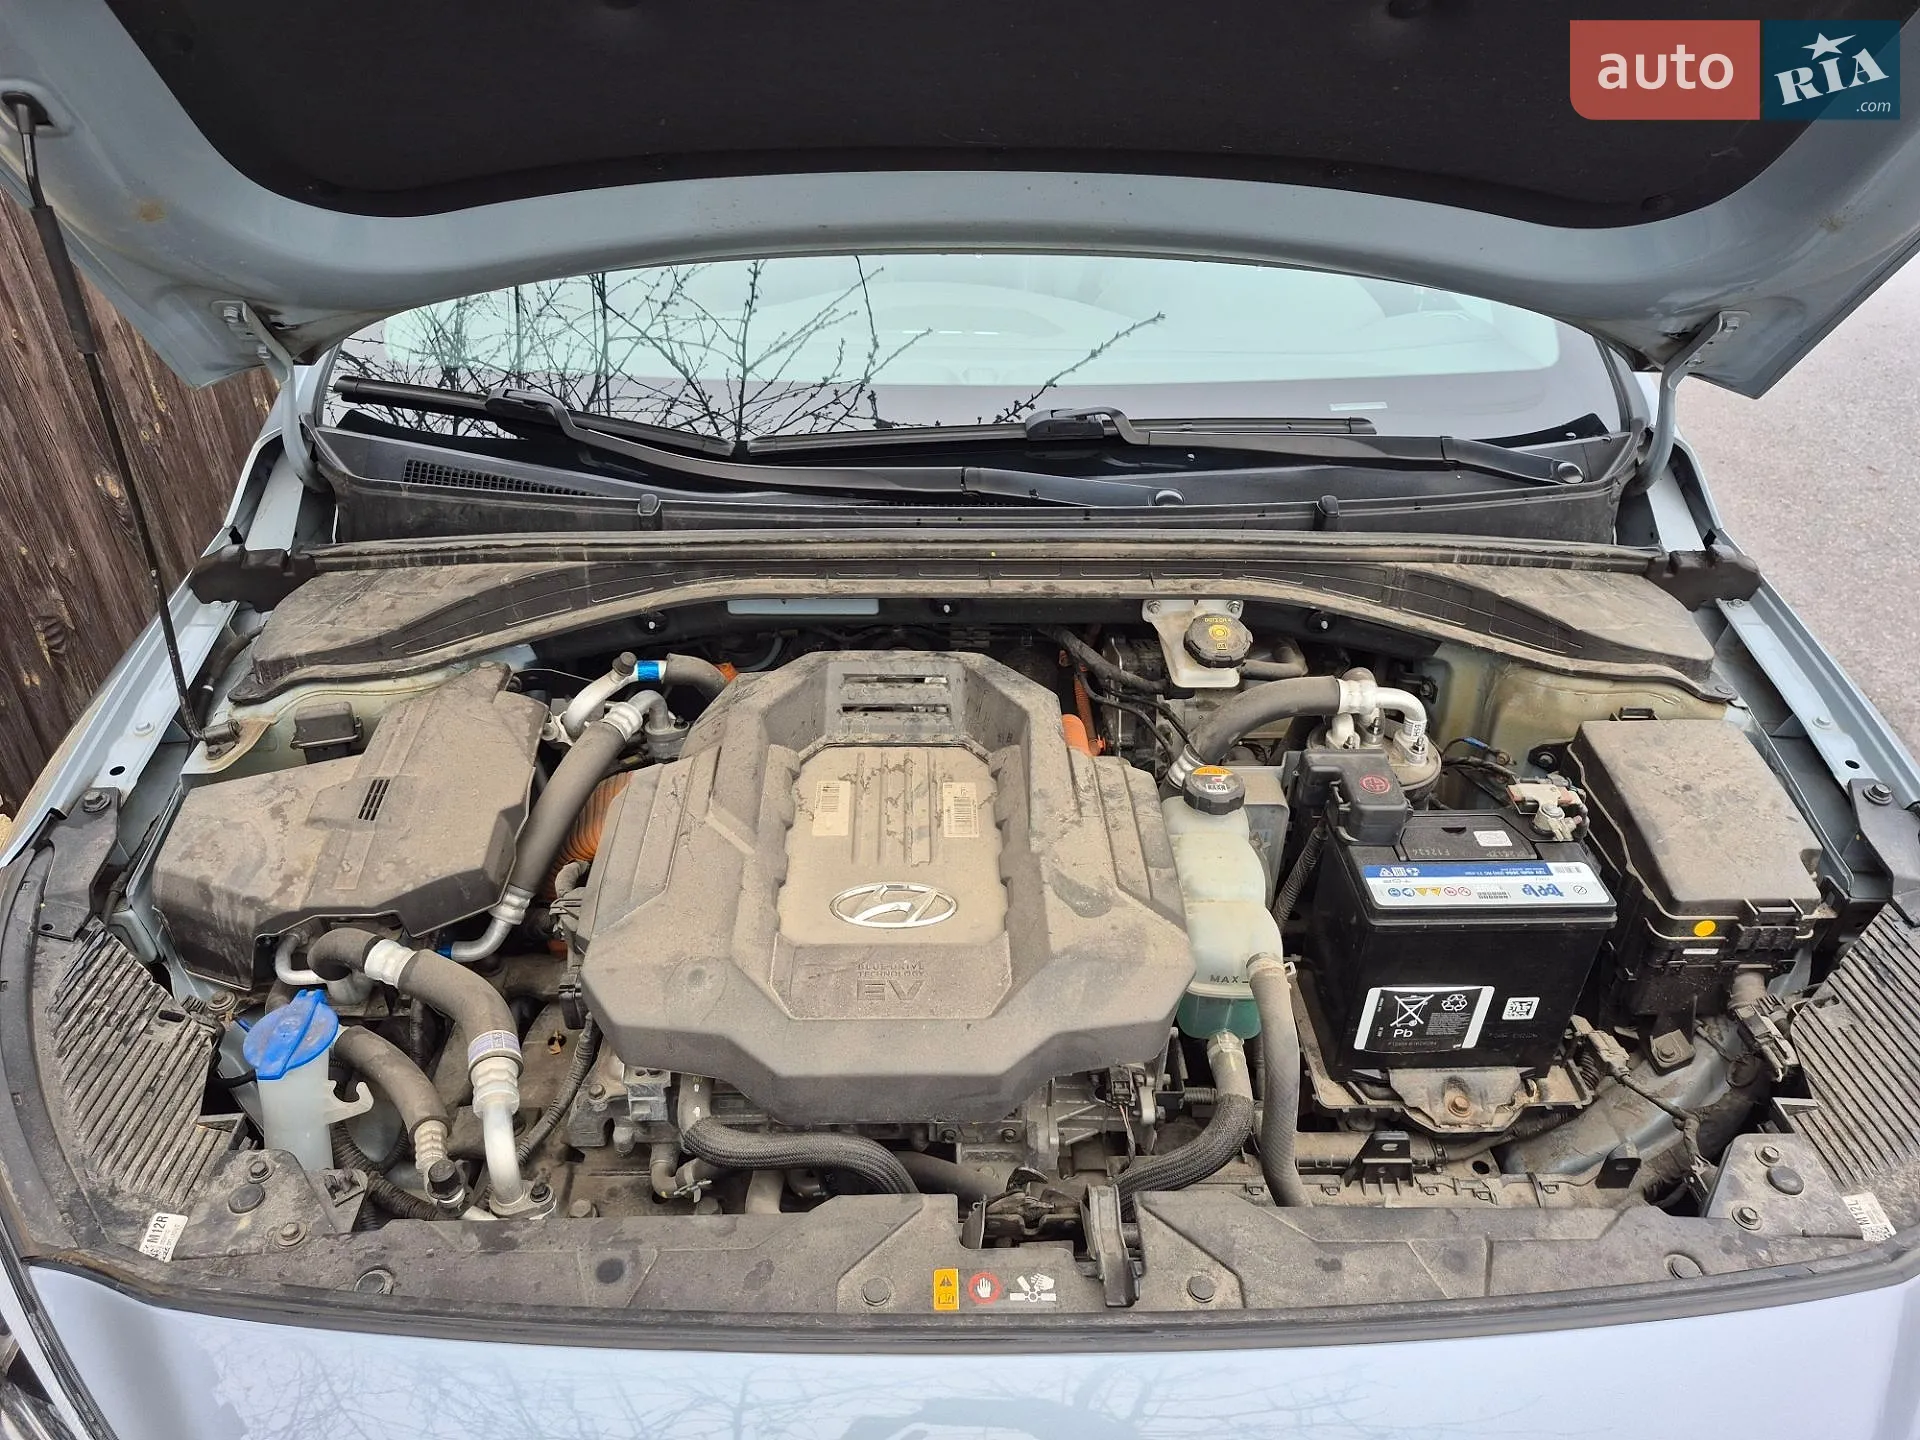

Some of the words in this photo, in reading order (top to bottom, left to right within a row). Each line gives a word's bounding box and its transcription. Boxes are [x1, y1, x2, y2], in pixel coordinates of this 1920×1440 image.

[1209, 974, 1240, 983] MAX
[857, 979, 925, 1001] EV
[1393, 1028, 1413, 1038] Pb
[146, 1215, 169, 1244] M12R
